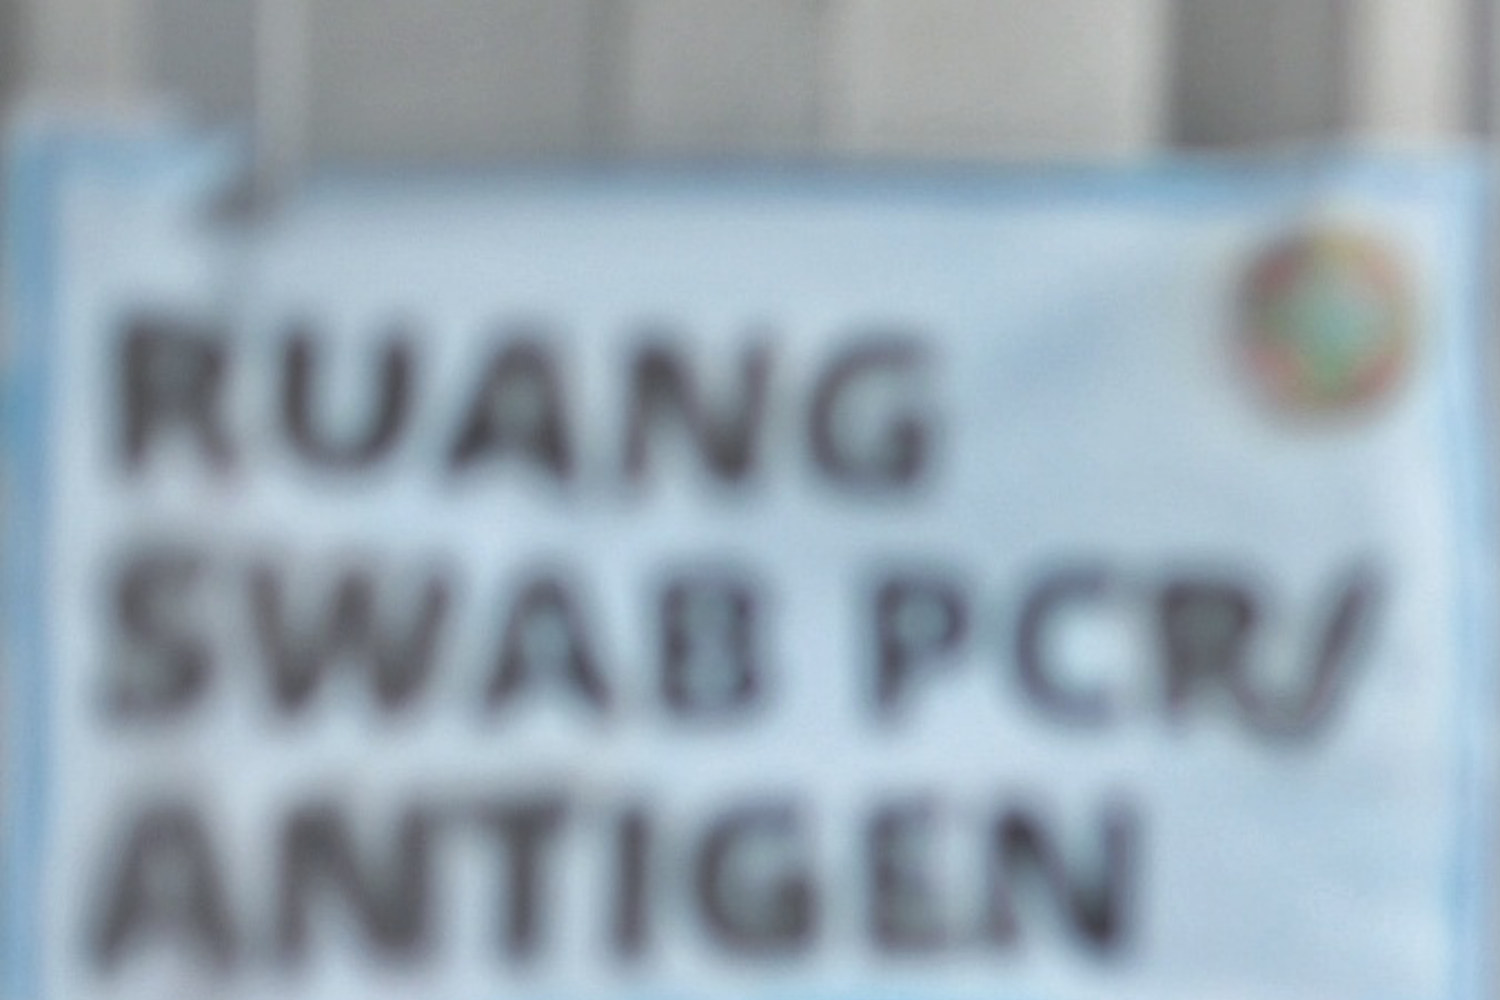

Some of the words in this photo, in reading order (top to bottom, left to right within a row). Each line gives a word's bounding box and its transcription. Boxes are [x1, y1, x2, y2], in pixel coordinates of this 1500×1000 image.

[108, 312, 936, 495] RUANG
[104, 546, 764, 732] SWAB
[865, 552, 1372, 742] PCR/
[84, 790, 1135, 975] ANTIGEN
